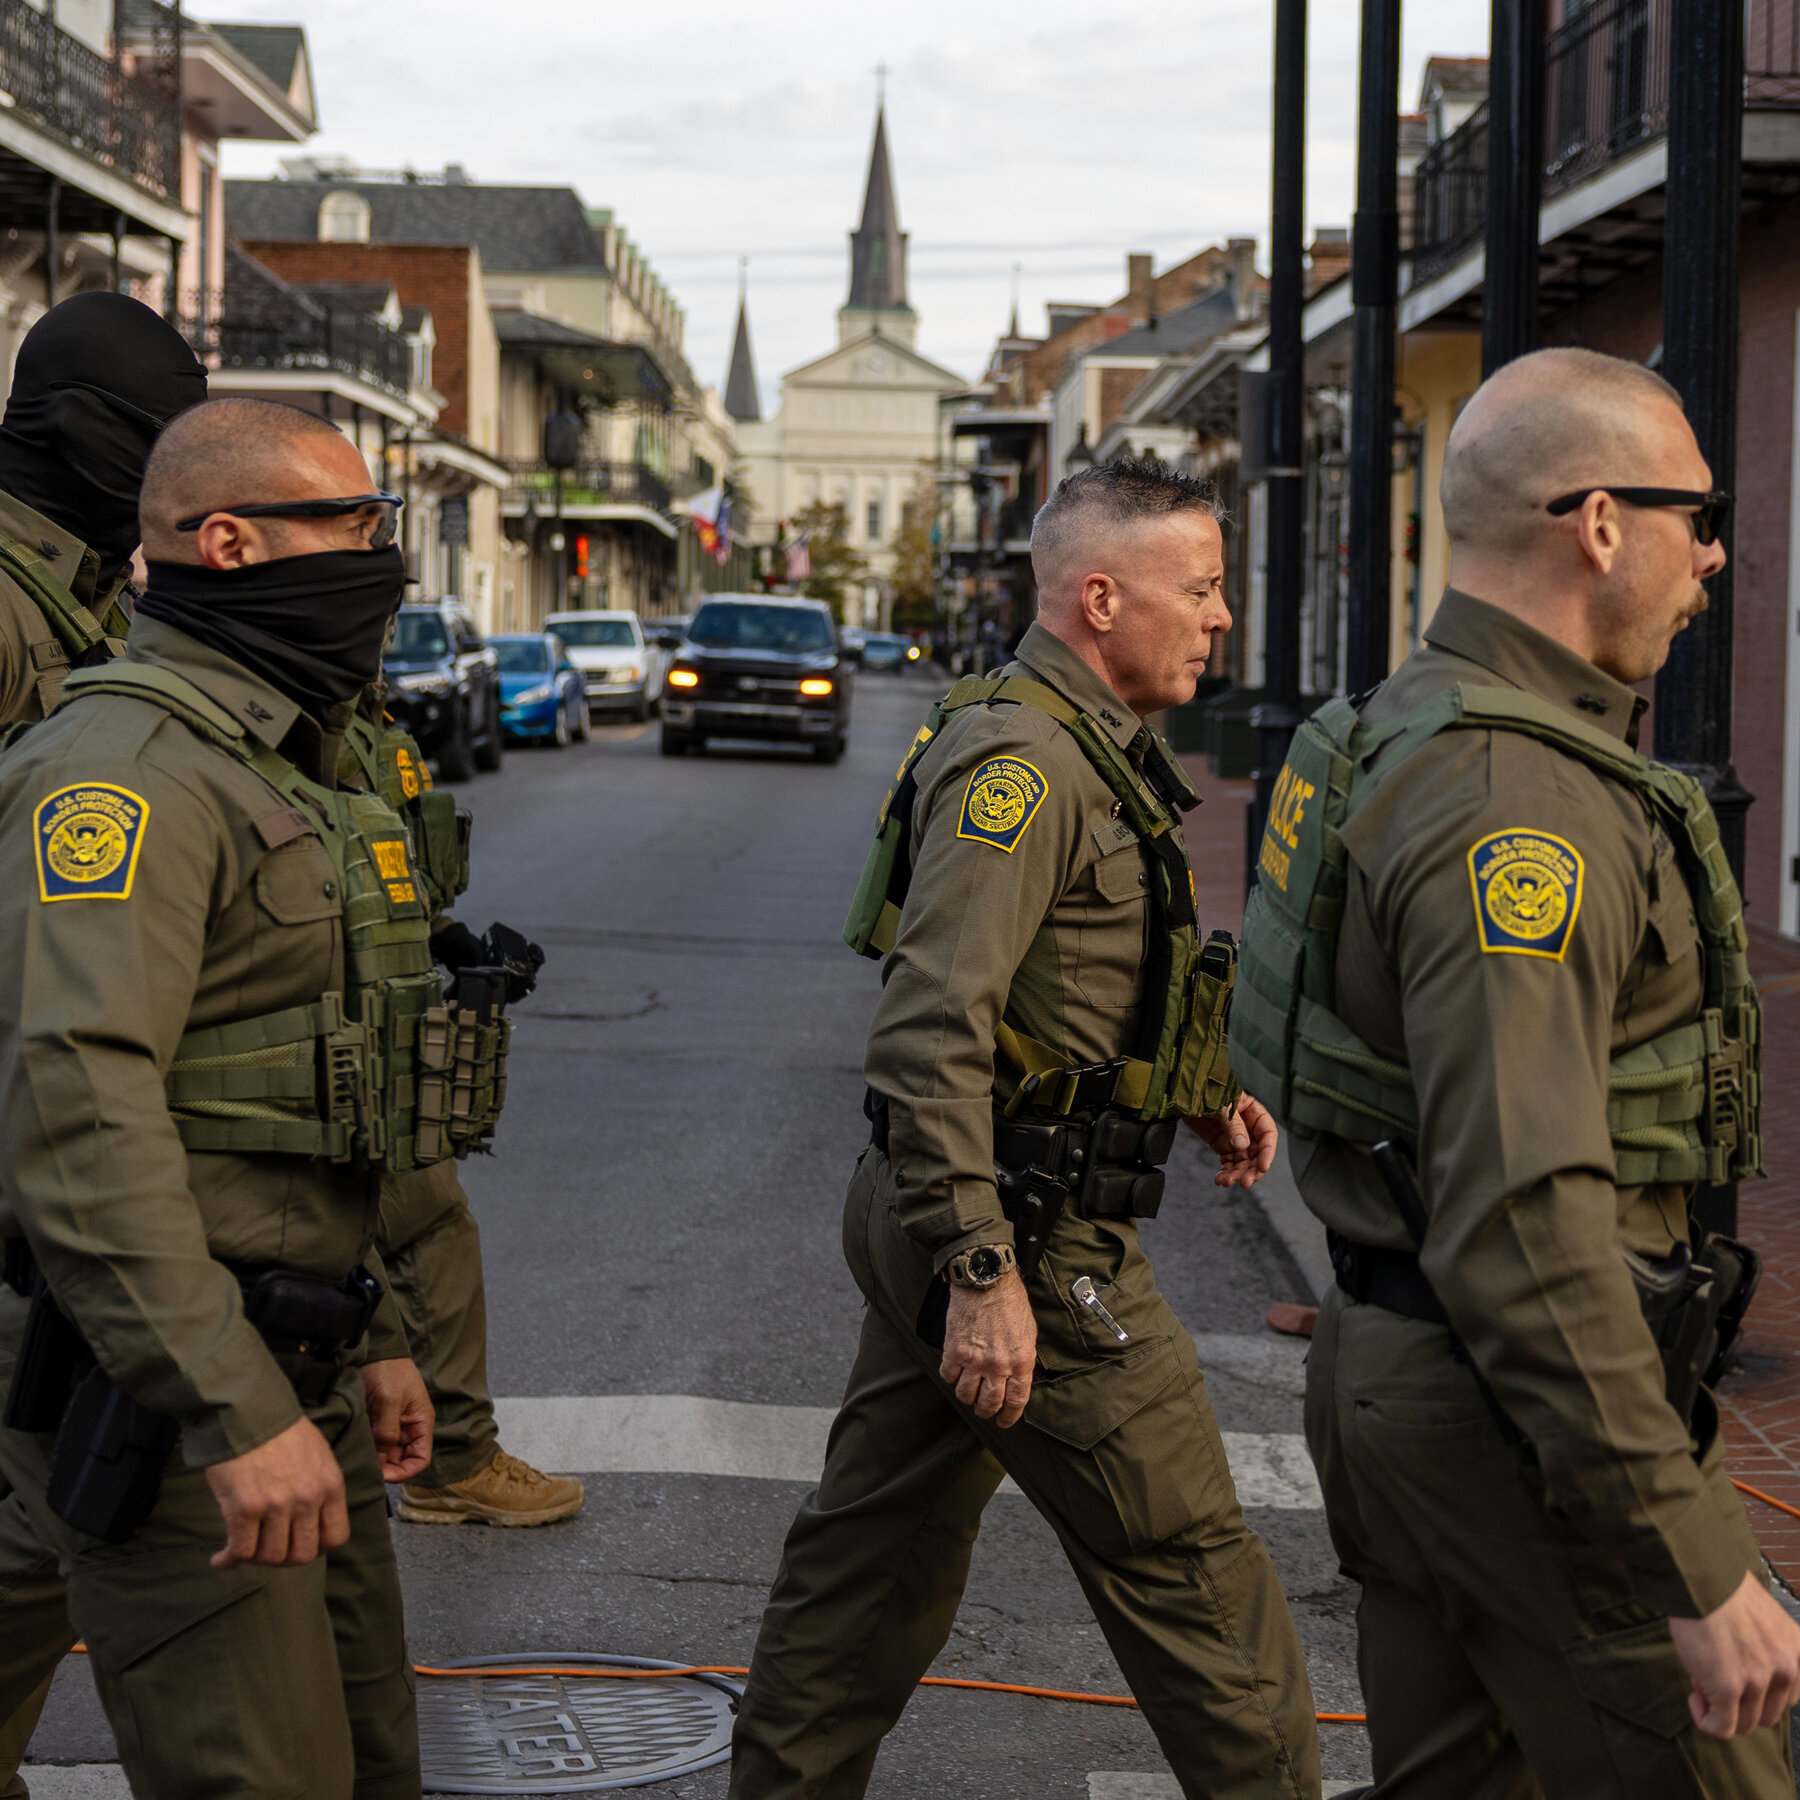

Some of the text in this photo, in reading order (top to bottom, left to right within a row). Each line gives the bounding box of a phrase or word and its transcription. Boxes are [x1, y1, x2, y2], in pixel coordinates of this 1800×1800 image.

[973, 770, 1035, 803] BORDER PROTECTION
[987, 762, 1040, 794] U.S. CUSTOMS AND
[55, 795, 75, 810] U.S.
[75, 791, 125, 808] CUSTOMS
[1270, 763, 1316, 850] OLICE
[42, 801, 135, 834] BORDER PROTECTION
[989, 815, 1020, 830] SECURITY
[1512, 837, 1563, 857] CUSTOMS
[481, 1675, 599, 1777] WATER
